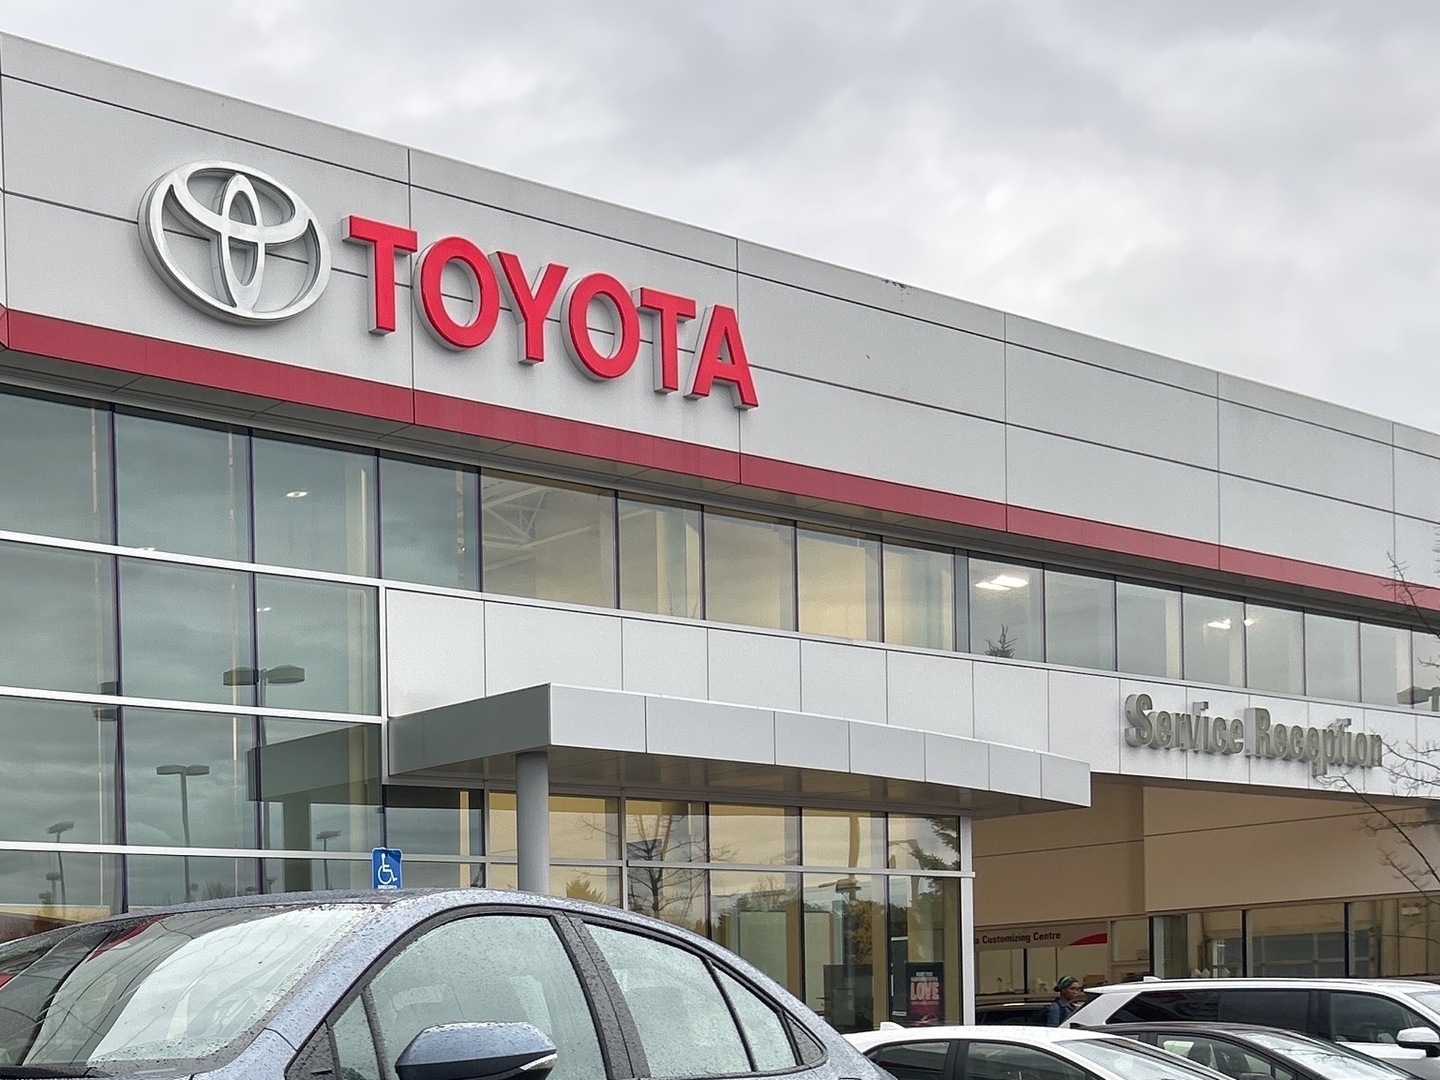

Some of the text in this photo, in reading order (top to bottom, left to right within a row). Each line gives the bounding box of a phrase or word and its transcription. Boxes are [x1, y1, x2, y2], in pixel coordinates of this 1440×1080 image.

[341, 214, 759, 411] TOYOTA
[1124, 693, 1383, 777] Service Reception
[982, 933, 1031, 945] Customizing
[1033, 931, 1061, 941] Centre
[910, 981, 940, 1001] LOVE
